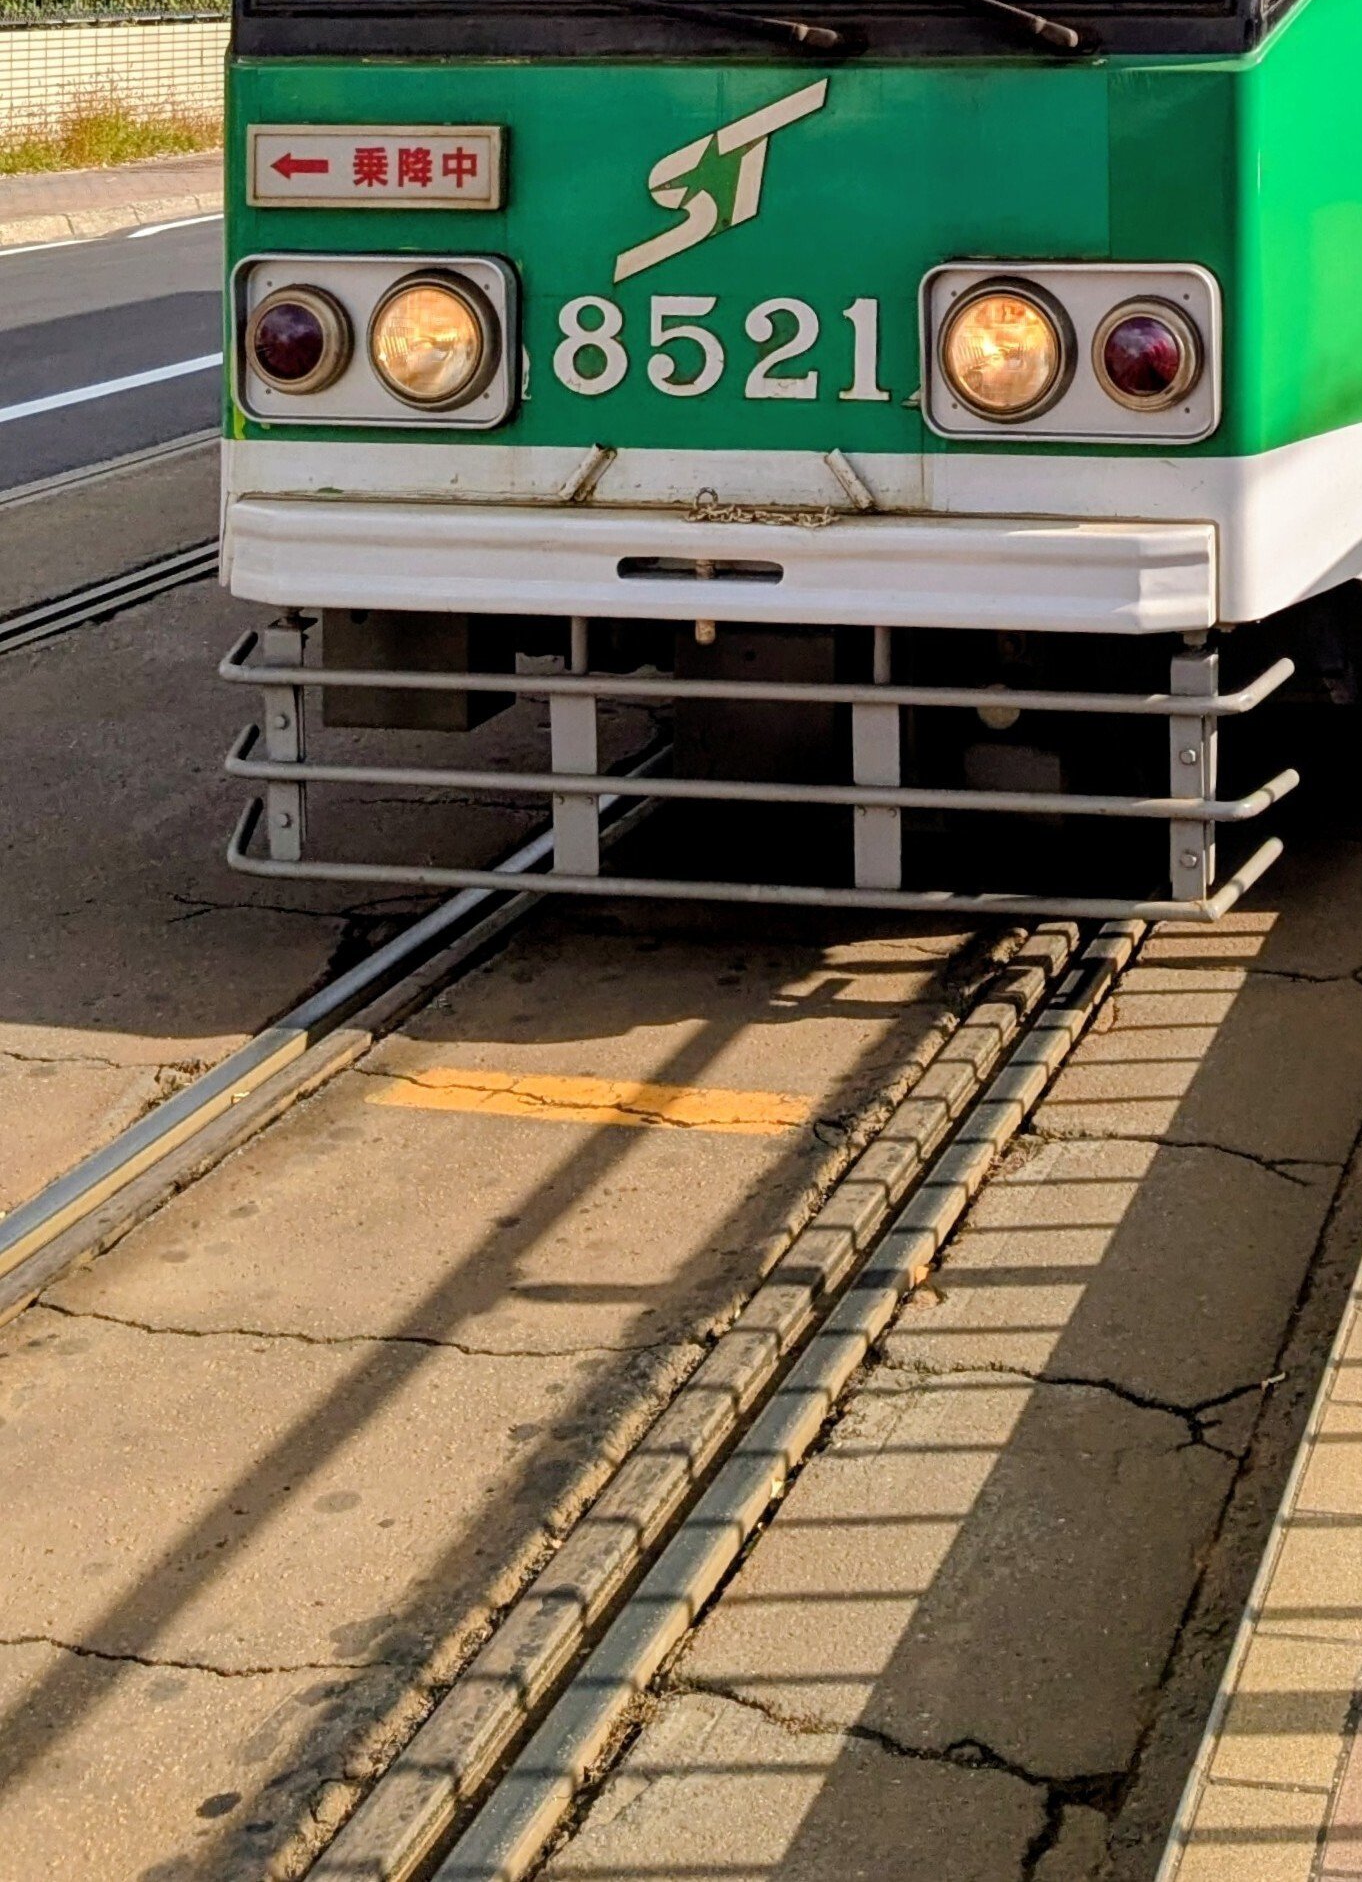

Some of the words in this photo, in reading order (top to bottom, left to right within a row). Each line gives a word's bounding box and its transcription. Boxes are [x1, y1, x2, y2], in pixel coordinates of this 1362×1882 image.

[352, 147, 478, 189] 乗降中
[613, 77, 829, 285] ST
[553, 295, 892, 402] 8521
